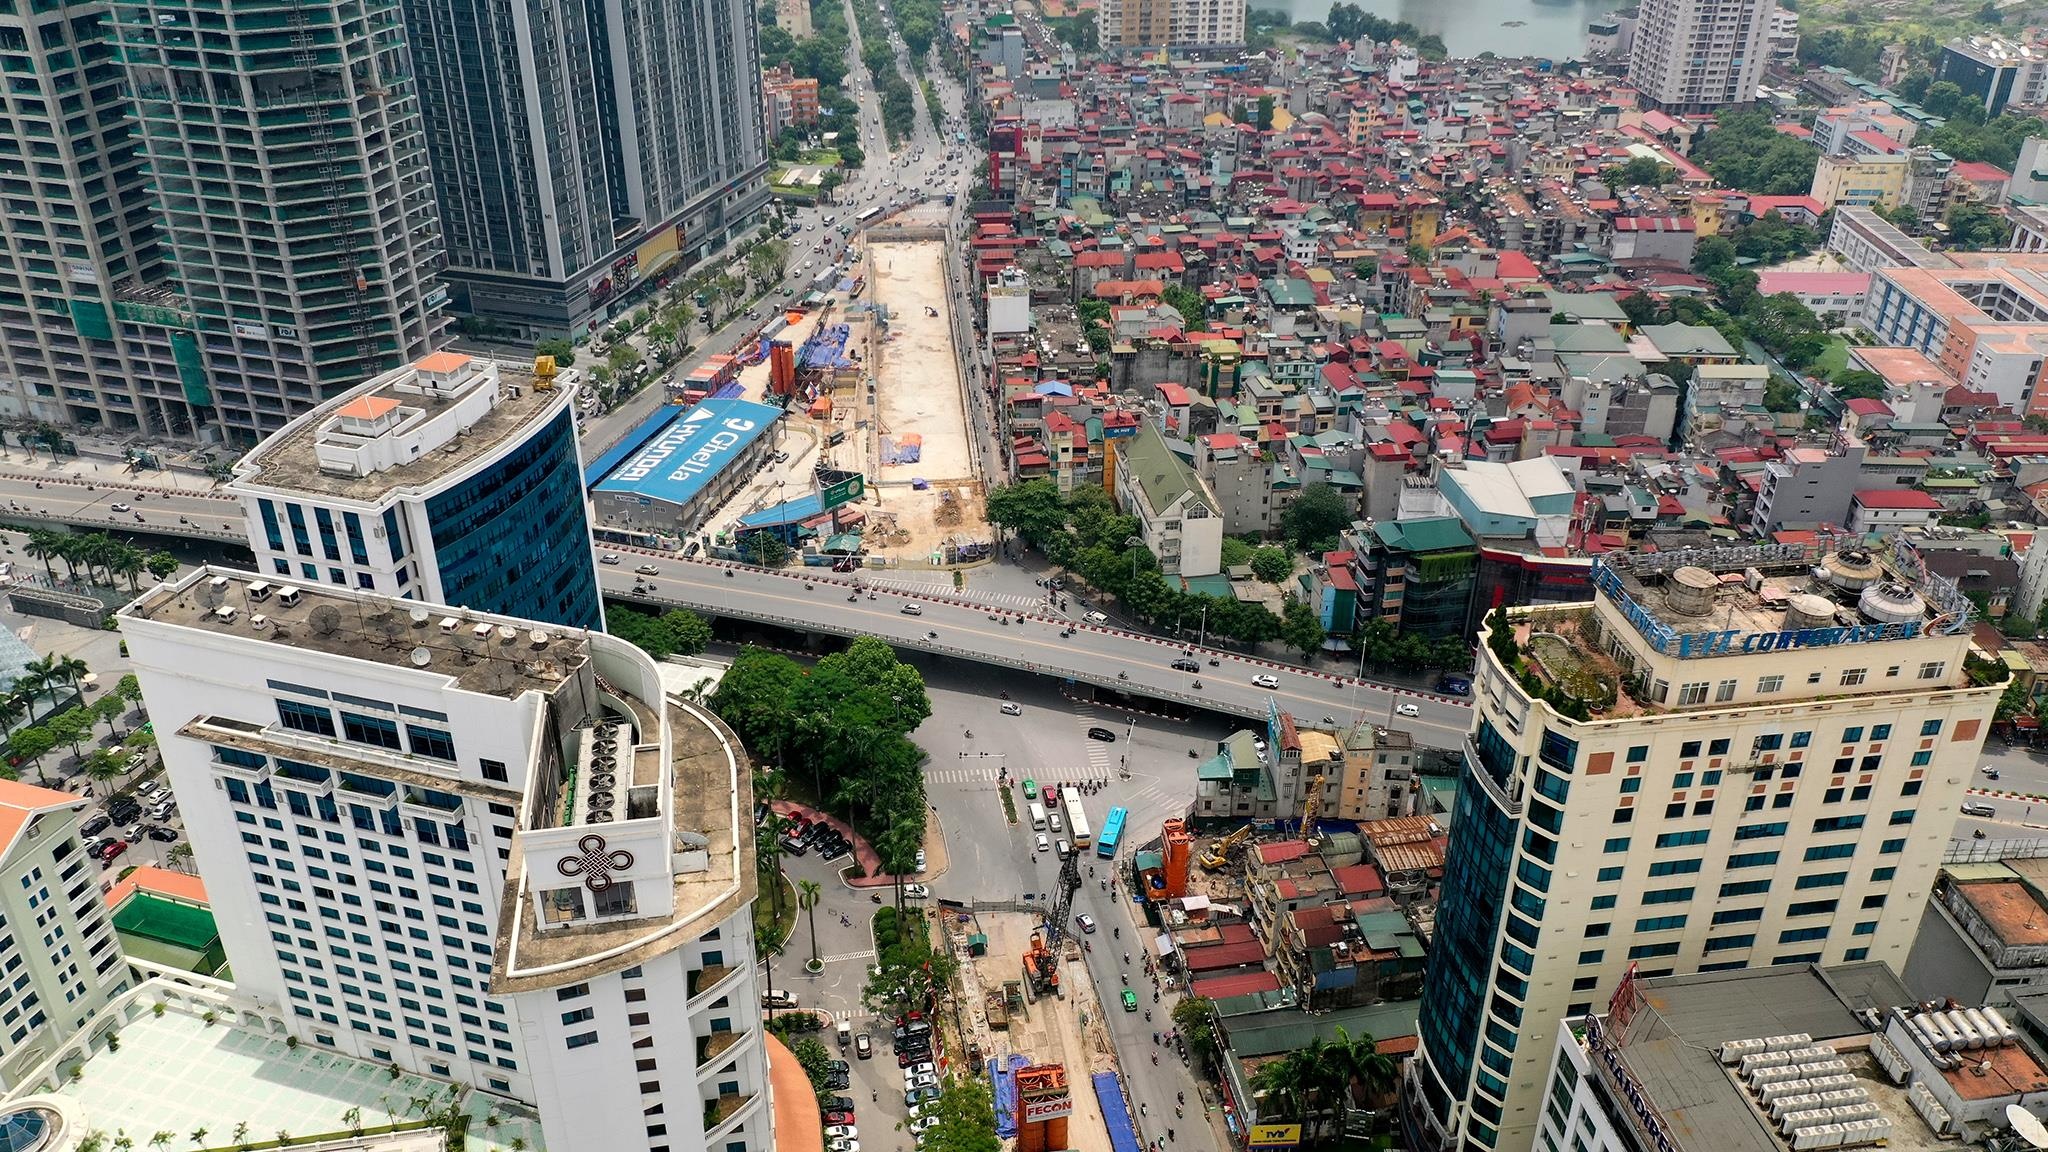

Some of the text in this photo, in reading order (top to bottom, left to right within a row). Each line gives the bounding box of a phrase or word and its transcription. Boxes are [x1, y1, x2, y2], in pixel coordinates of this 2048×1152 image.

[620, 424, 702, 481] HYUNDAI
[667, 431, 739, 481] Ghella
[1678, 629, 1741, 658] VIT
[1027, 1101, 1072, 1117] FECON
